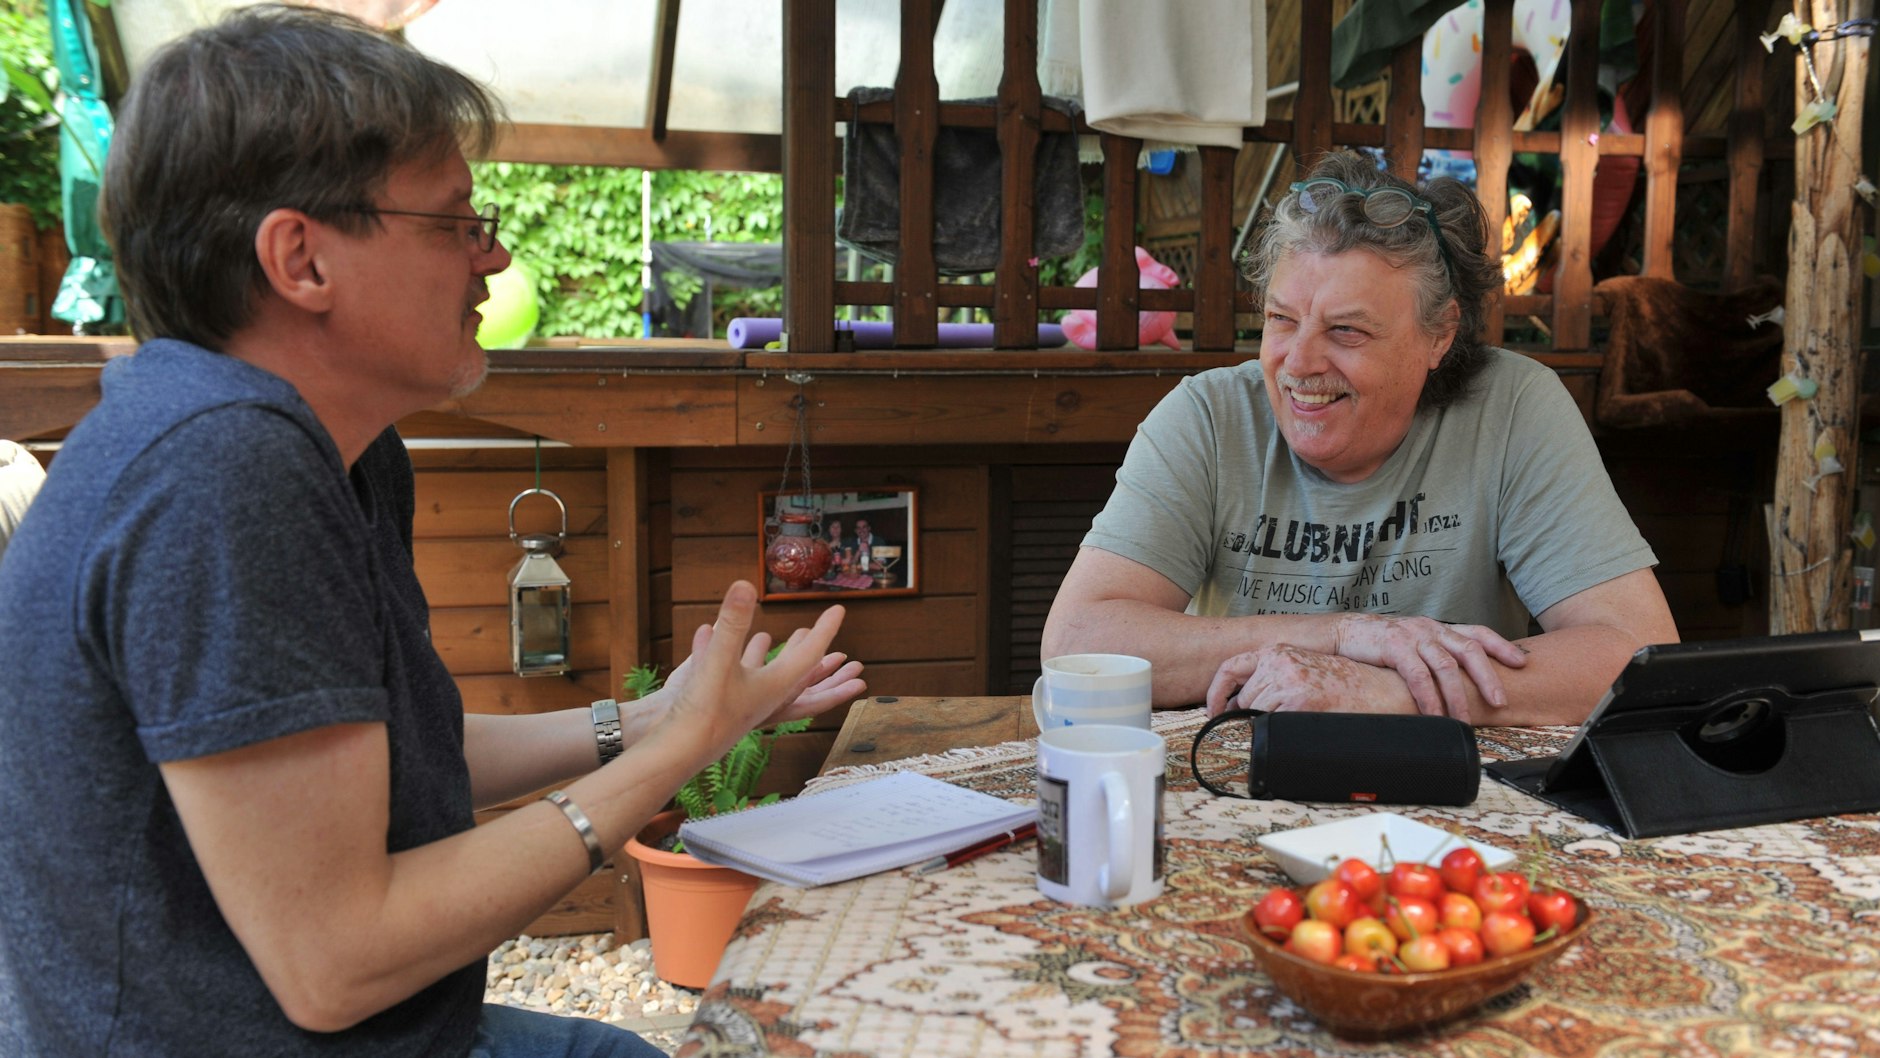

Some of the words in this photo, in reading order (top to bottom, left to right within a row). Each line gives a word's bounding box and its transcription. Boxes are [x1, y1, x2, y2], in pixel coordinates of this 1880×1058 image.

[1248, 493, 1425, 563] CLUBNIHT
[1237, 576, 1263, 600] IVE
[1267, 581, 1323, 606] MUSIC
[1382, 555, 1432, 583] LONG
